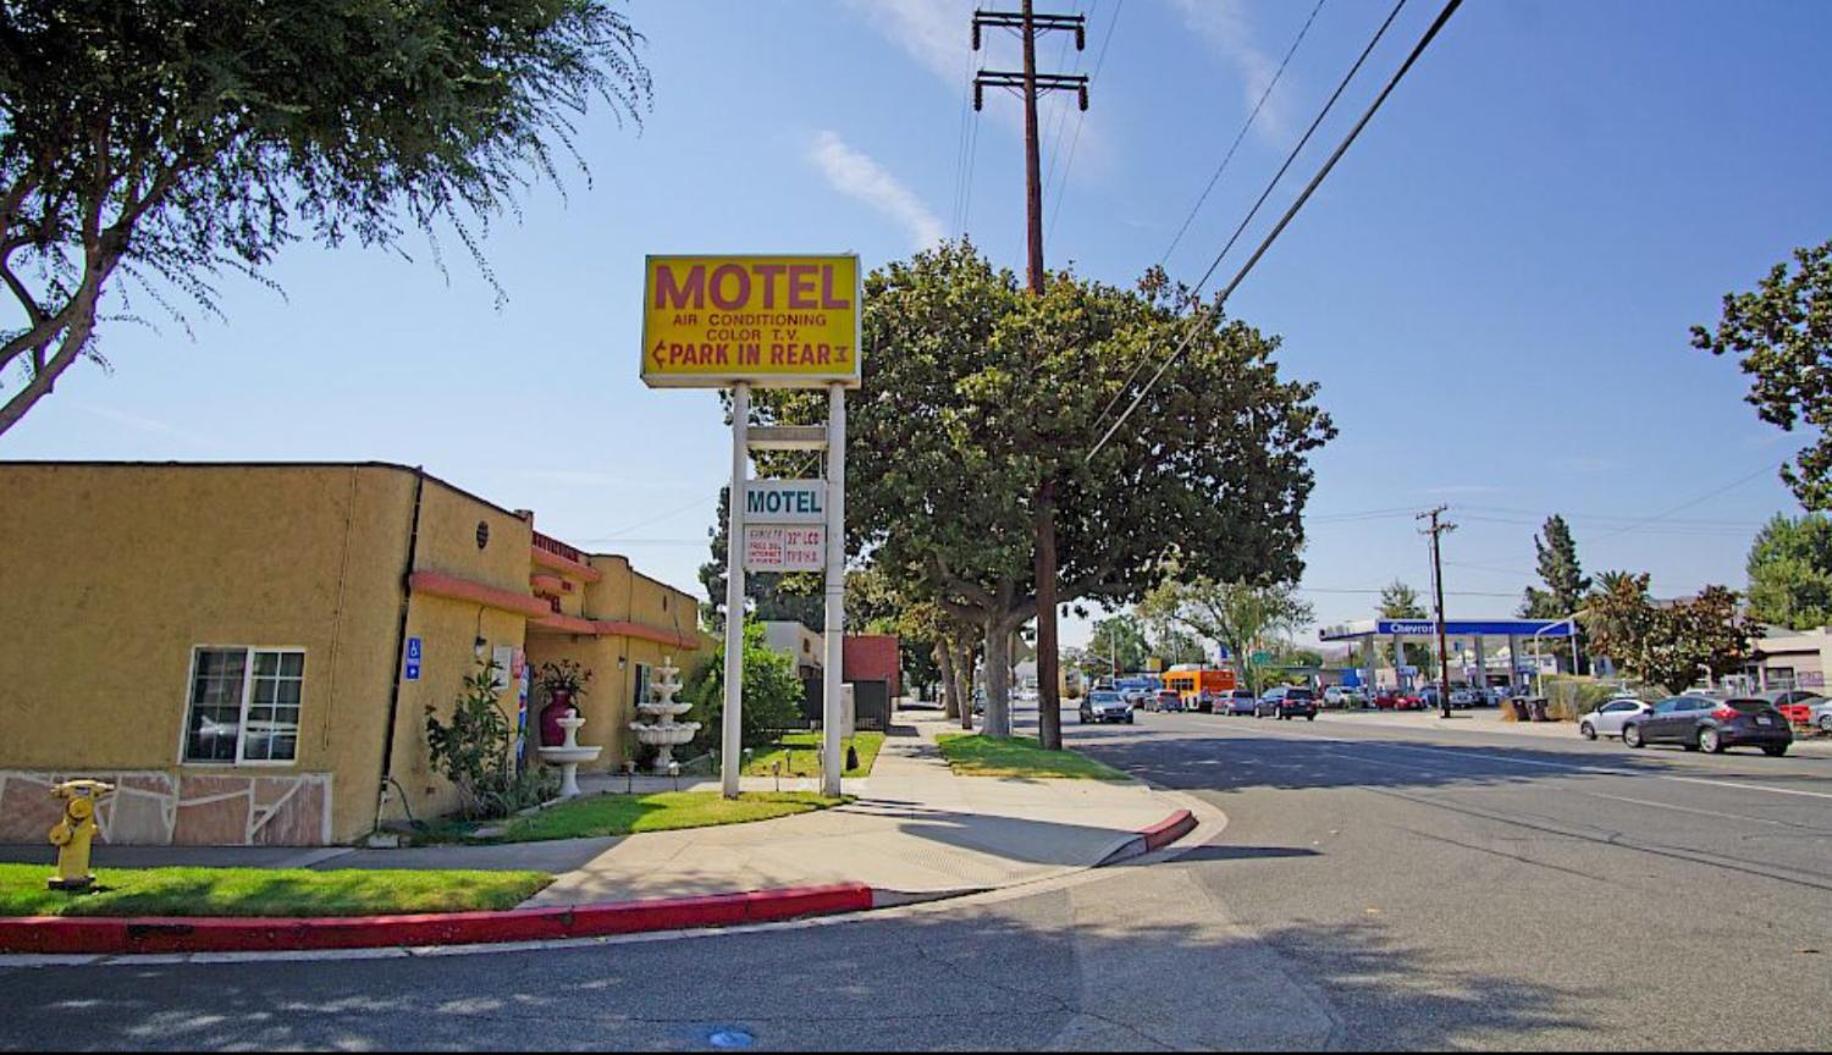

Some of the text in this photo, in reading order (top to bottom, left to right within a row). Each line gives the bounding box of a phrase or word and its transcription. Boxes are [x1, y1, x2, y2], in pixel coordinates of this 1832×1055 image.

[655, 264, 849, 310] MOTEL
[673, 314, 827, 326] AIR CONDITIONING
[706, 329, 761, 342] COLOR
[669, 343, 831, 365] PARK IN REAR
[747, 490, 822, 513] MOTEL
